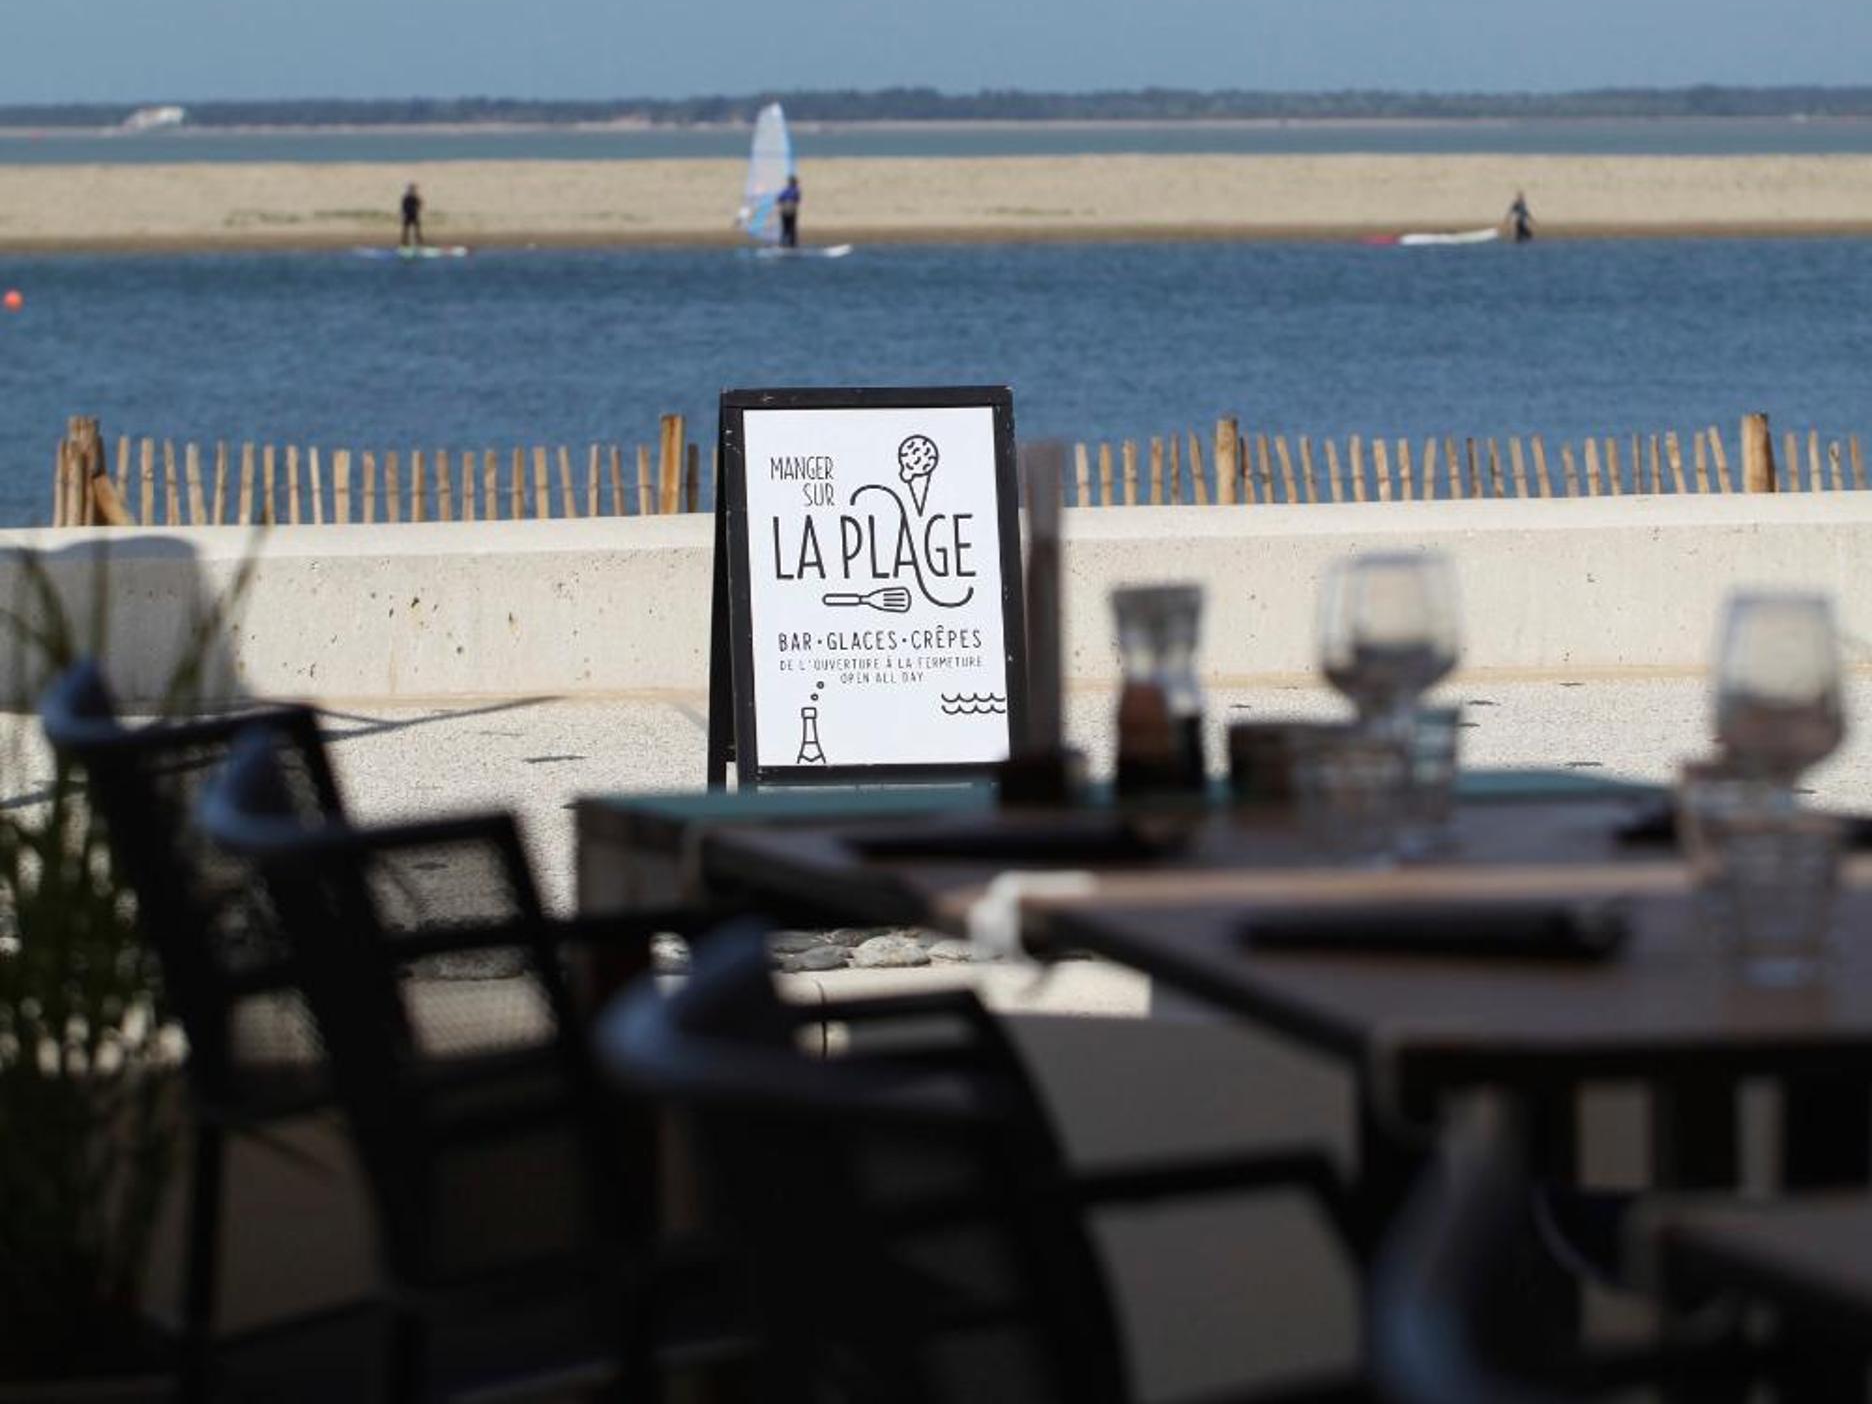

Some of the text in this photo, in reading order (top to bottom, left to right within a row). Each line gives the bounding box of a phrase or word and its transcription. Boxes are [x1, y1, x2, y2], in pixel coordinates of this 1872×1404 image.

[770, 456, 835, 481] MANGER
[802, 482, 835, 507] SUR
[772, 484, 977, 608] LA PLAGE
[778, 624, 982, 652] BAR GLACES CRÊPES
[779, 659, 793, 671] DE
[898, 657, 912, 669] LA
[918, 656, 981, 669] FERMETURE
[840, 671, 923, 684] OPEN ALL DAY
